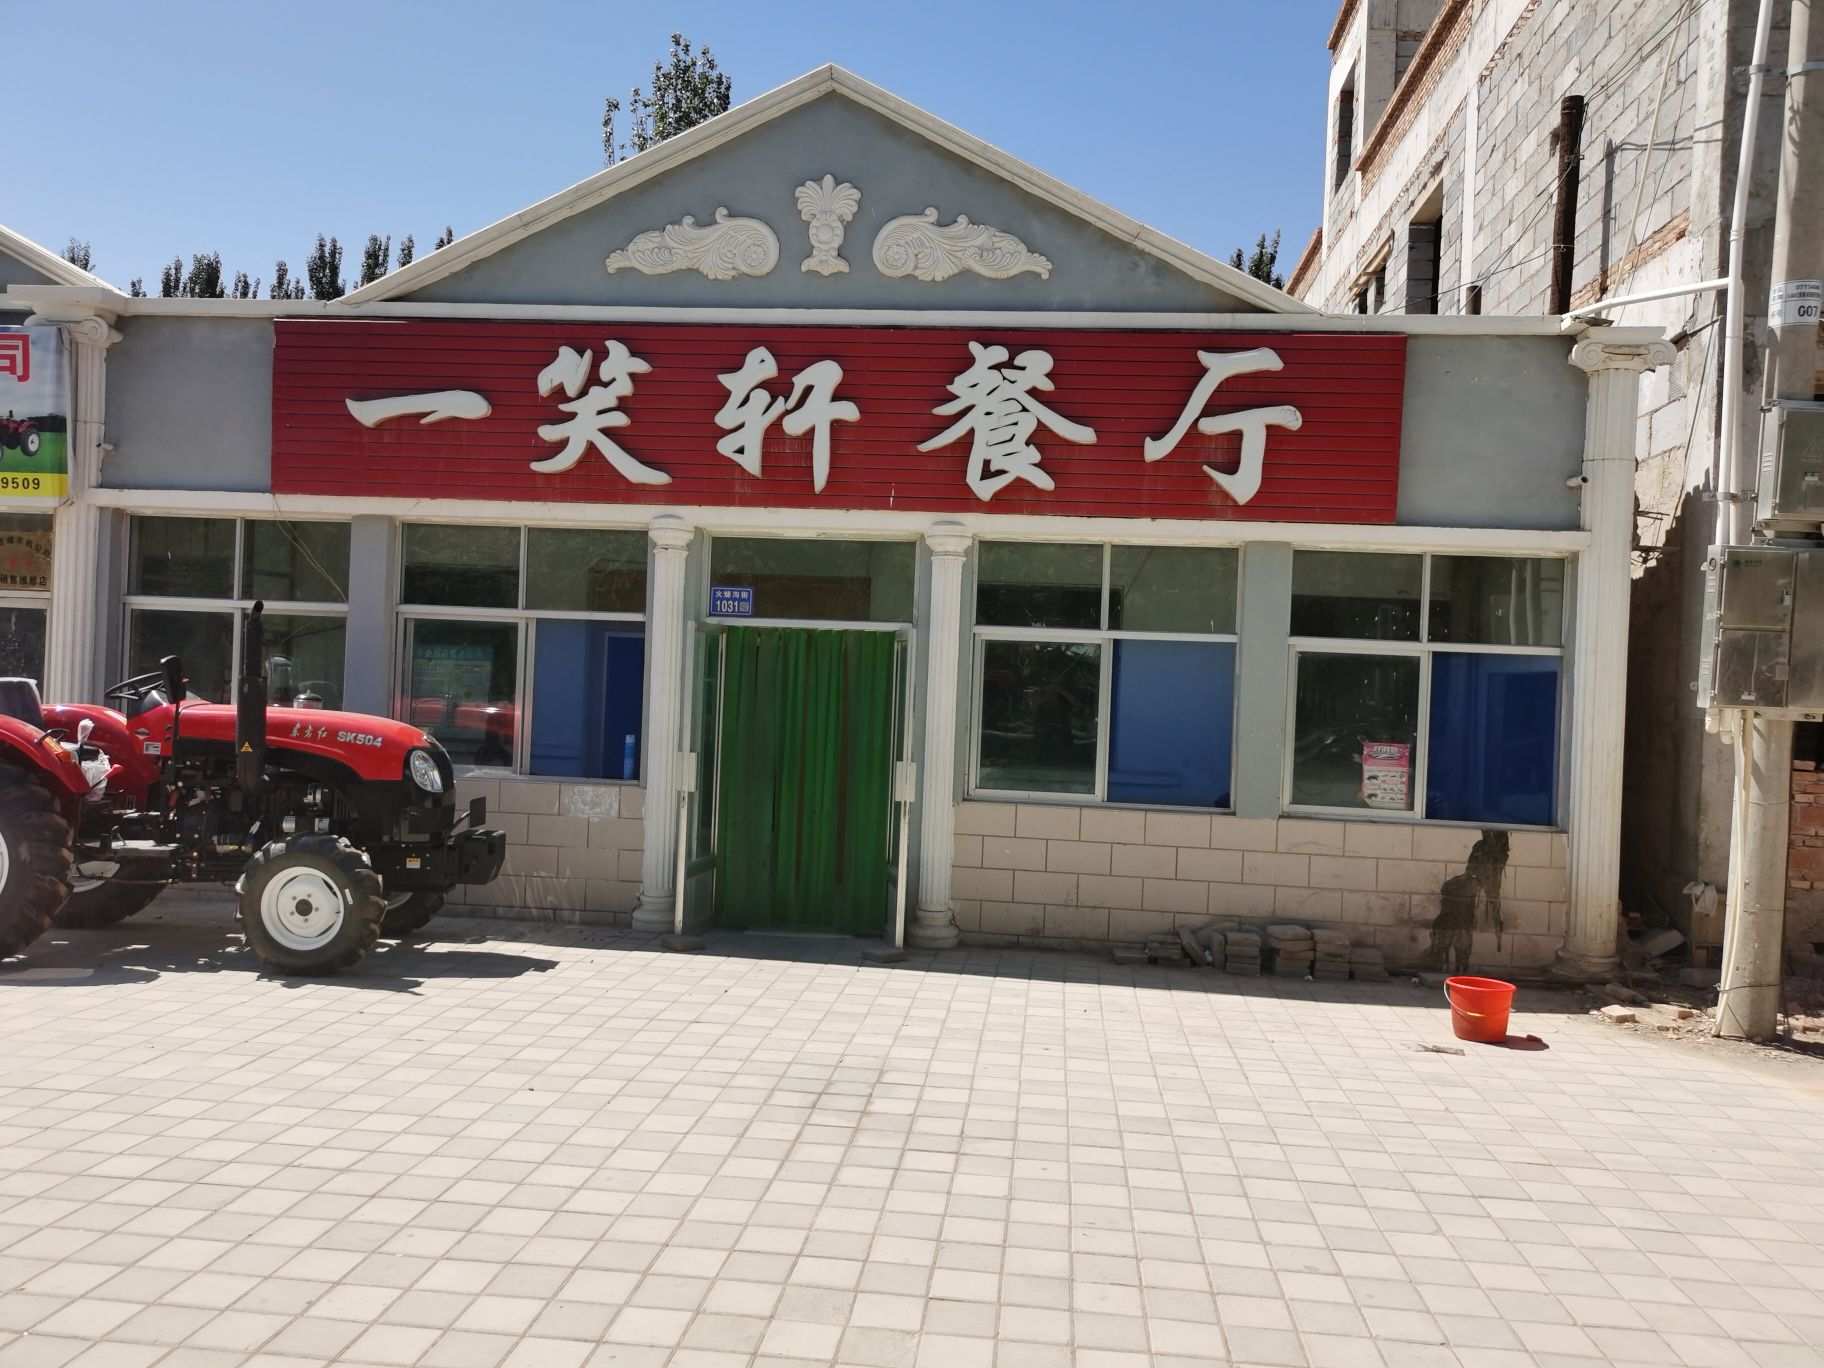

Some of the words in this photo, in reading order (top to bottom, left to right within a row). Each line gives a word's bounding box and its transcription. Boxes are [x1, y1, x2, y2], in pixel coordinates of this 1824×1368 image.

[346, 340, 1303, 505] 一笑轩餐厅
[290, 721, 328, 740] 东方红
[337, 731, 382, 748] SK504
